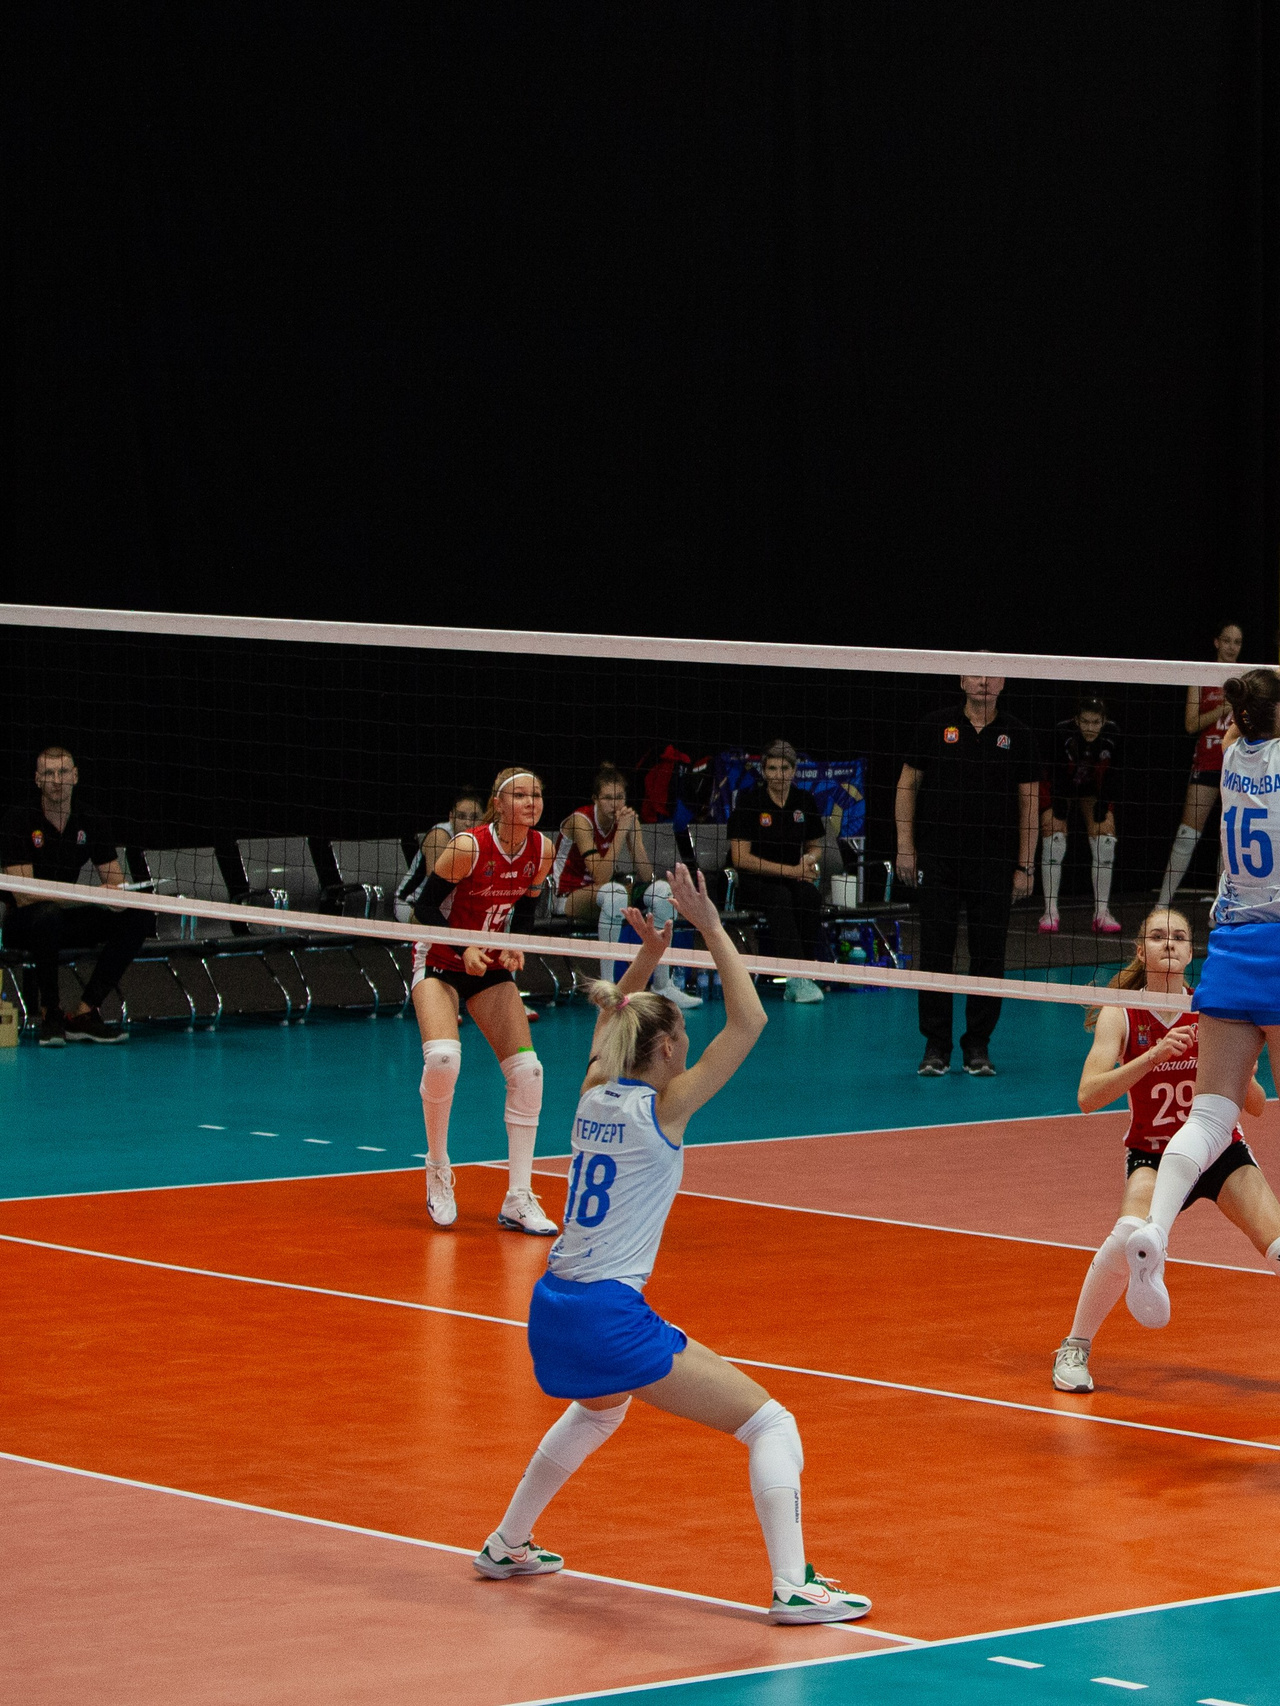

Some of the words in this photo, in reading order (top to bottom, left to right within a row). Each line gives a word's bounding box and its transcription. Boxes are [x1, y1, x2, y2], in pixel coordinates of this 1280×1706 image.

[1223, 806, 1274, 878] 15
[1151, 1080, 1197, 1127] 29
[566, 1151, 617, 1228] 18
